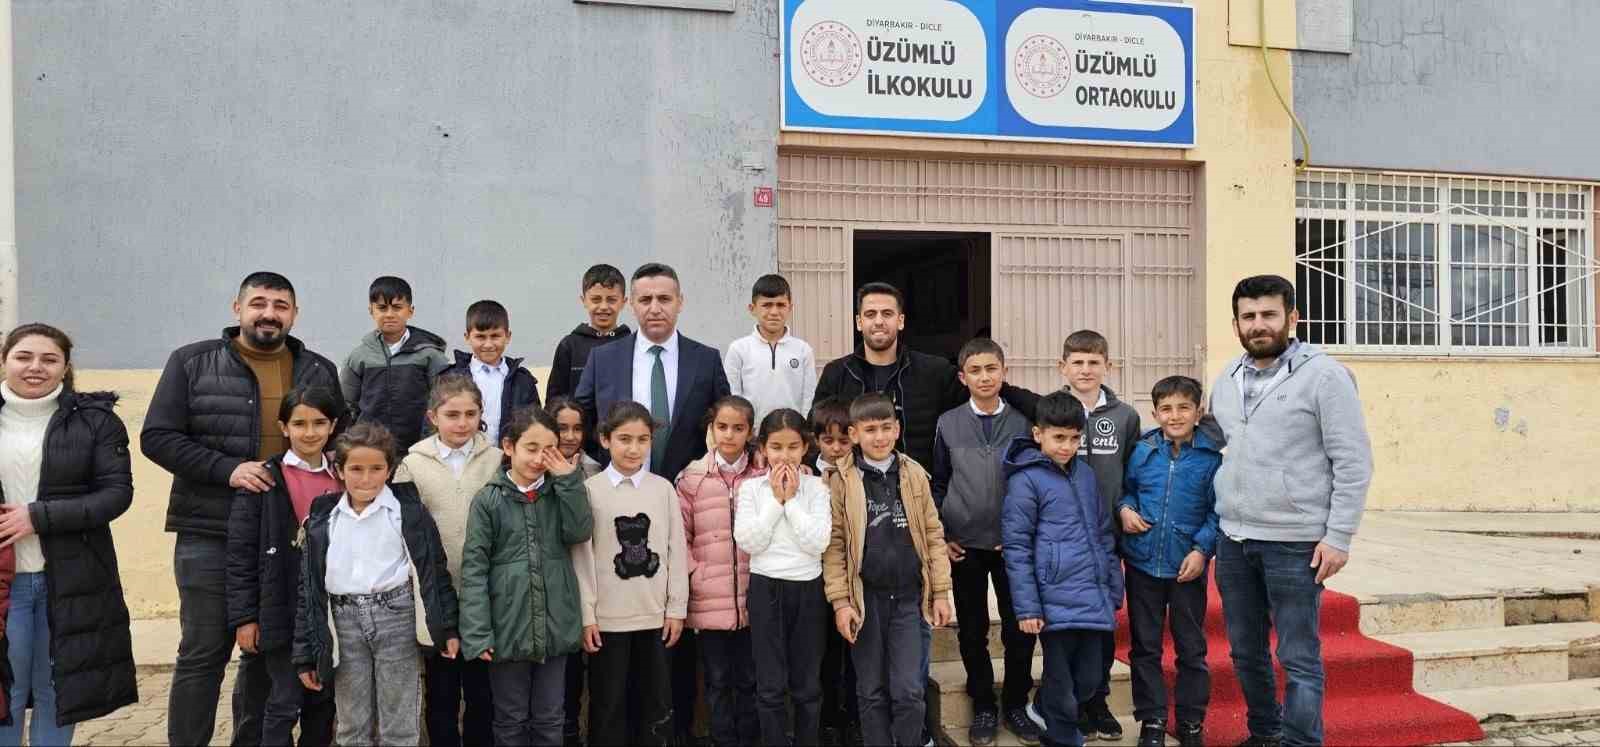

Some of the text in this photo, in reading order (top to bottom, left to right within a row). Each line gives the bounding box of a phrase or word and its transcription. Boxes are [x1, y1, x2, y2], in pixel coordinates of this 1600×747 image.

[867, 36, 956, 66] ÜZÜMLÜ
[1075, 50, 1157, 78] ÜZÜMLÜ
[867, 69, 973, 99] İLKOKULU
[1075, 86, 1176, 110] ORTAOKULU
